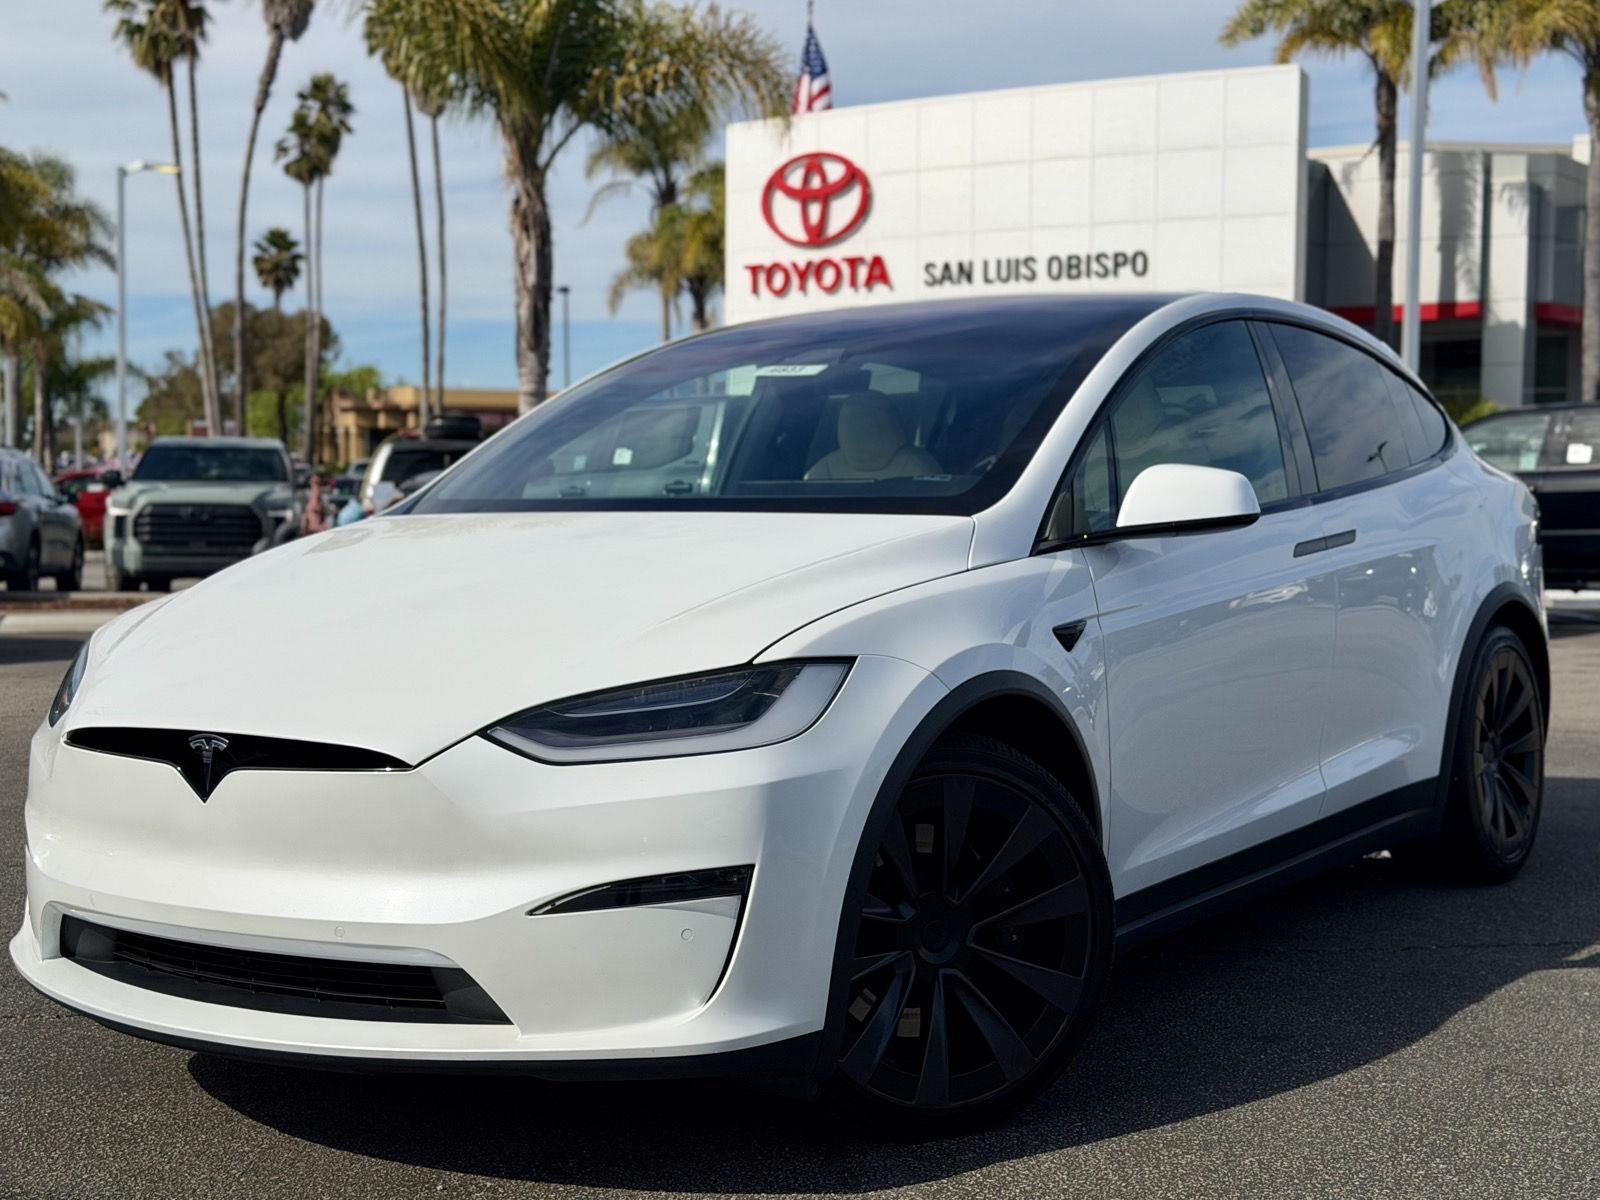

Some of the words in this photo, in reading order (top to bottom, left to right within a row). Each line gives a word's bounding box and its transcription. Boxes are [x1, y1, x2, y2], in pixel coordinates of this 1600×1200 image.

[745, 255, 892, 297] TOYOTA
[924, 261, 973, 286] SAN
[983, 257, 1037, 284] LUIS
[1047, 250, 1149, 281] OBISPO
